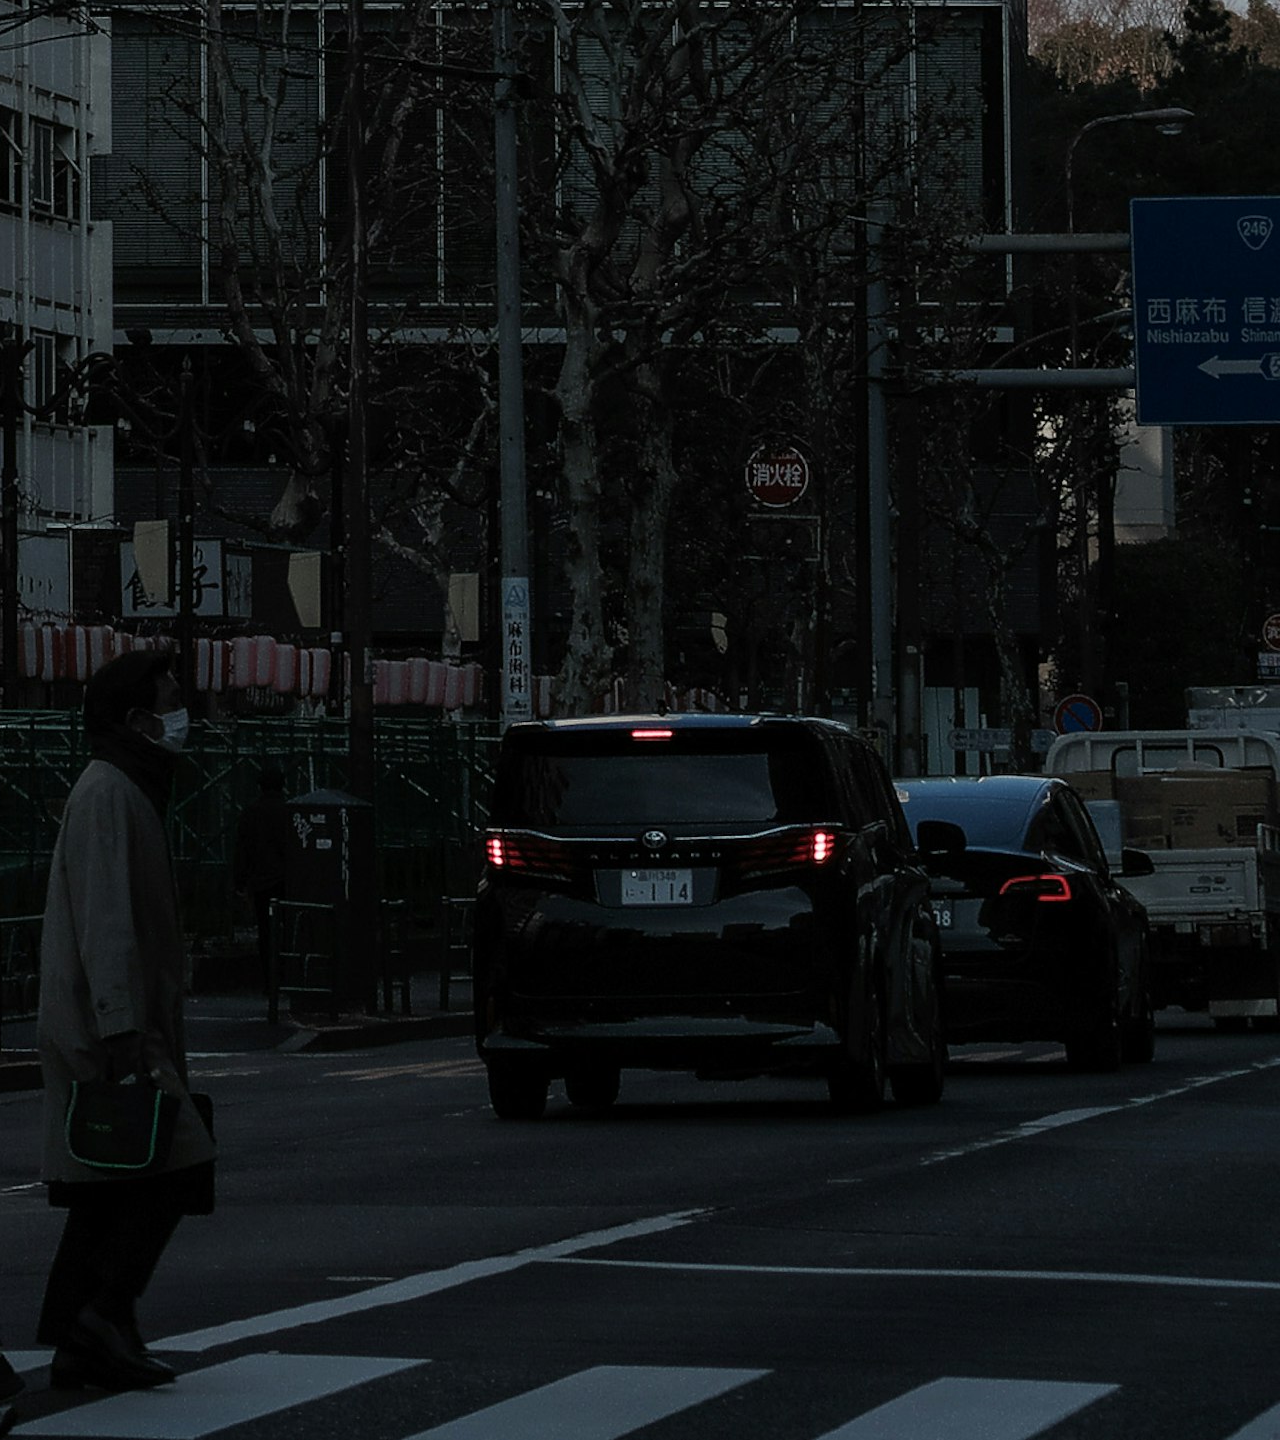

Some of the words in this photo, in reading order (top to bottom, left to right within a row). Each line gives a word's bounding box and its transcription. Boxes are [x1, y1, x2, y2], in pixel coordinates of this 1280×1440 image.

[1243, 221, 1268, 237] 246
[1146, 296, 1227, 325] 西麻布
[1146, 327, 1230, 344] Nishiazabu
[751, 462, 804, 487] 消火栓
[508, 621, 523, 693] 麻布歯科
